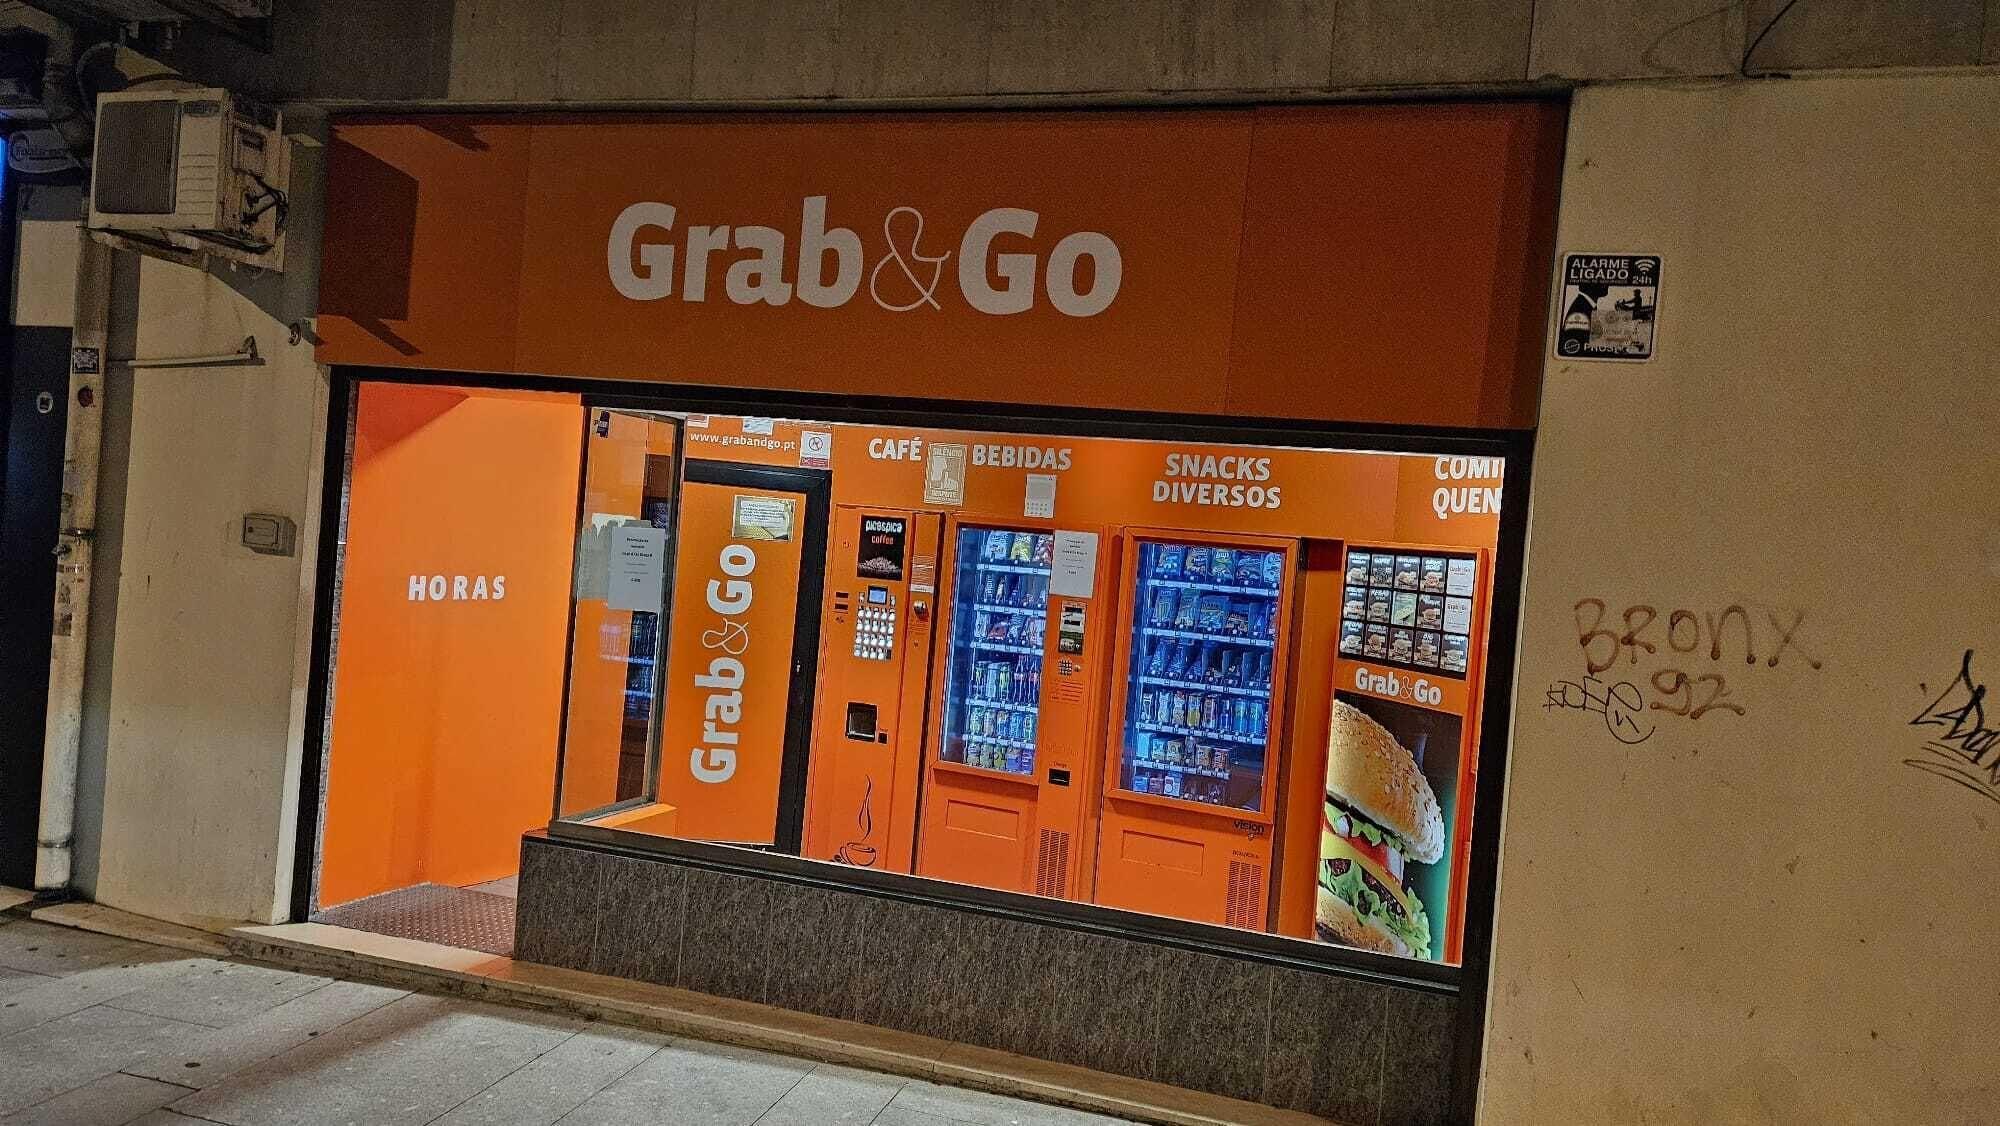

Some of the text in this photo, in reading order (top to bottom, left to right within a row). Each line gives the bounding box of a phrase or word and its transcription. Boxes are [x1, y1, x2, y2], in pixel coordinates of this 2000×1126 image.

[607, 195, 1123, 317] Grab&Go
[1572, 258, 1629, 269] ALARME
[1570, 268, 1629, 280] LIGADO
[1632, 275, 1652, 285] 24h
[689, 432, 796, 451] www.grabandgo.pt
[868, 437, 922, 461] CAFÉ
[972, 445, 1072, 471] BEBIDAS
[1165, 453, 1271, 481] SNACKS
[1434, 456, 1506, 480] COMI
[1152, 480, 1281, 508] DIVERSOS
[408, 575, 506, 601] HORAS
[690, 544, 756, 784] Grab&Go
[1355, 667, 1442, 705] Grab&Go
